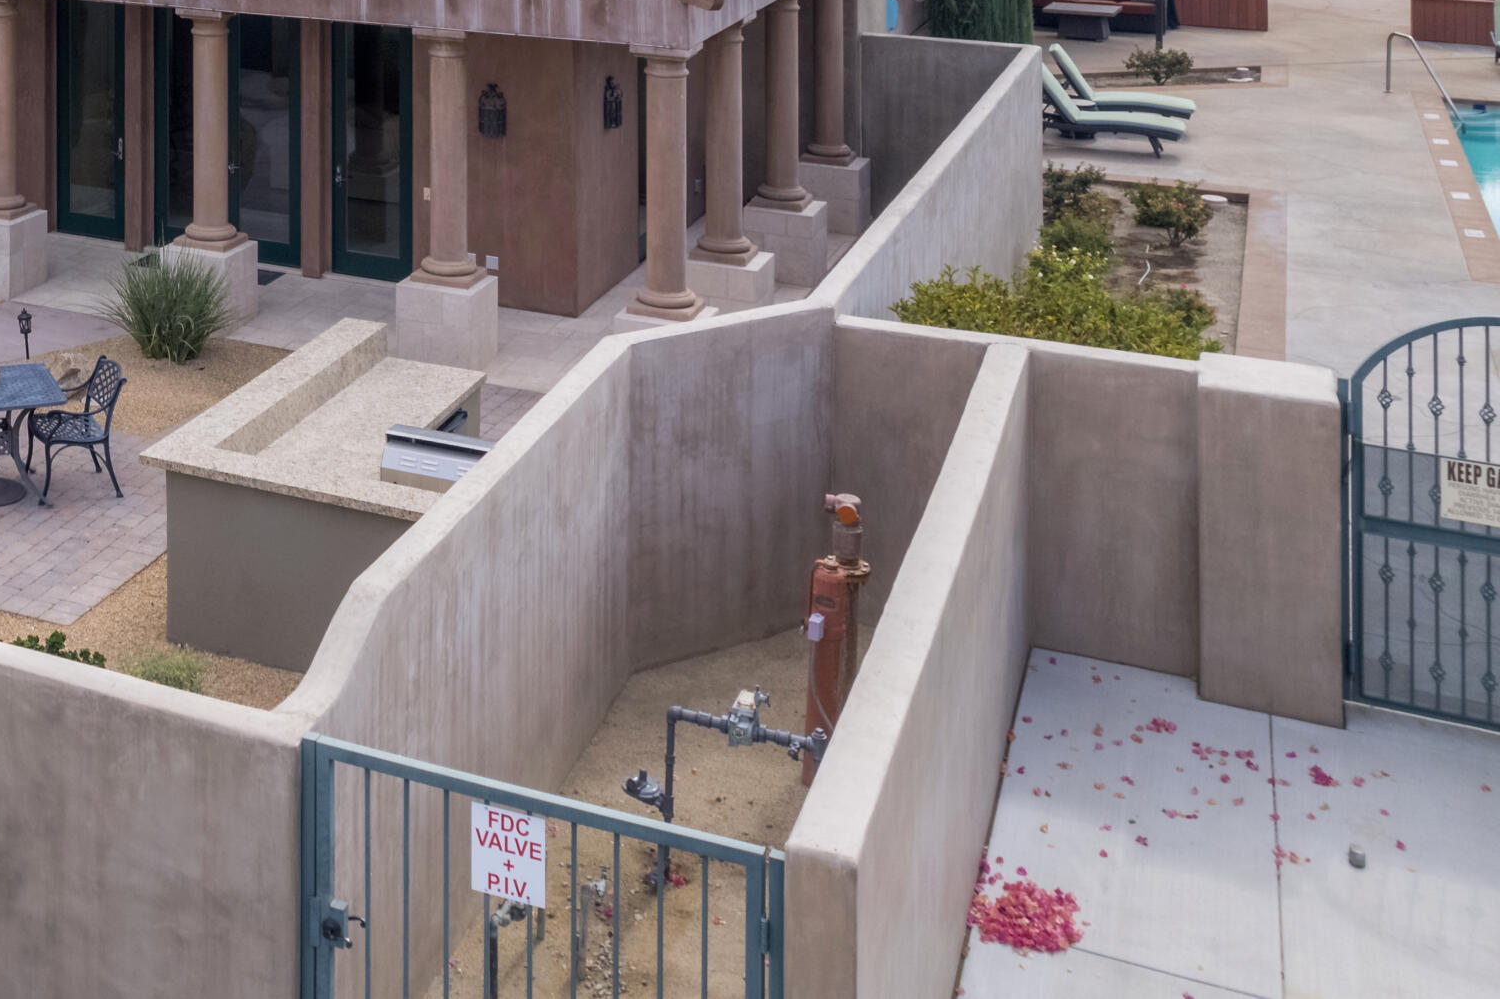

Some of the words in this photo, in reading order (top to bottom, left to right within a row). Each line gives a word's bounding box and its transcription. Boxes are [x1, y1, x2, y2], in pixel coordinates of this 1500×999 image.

[1447, 460, 1482, 485] KEEP
[488, 810, 529, 836] FDC
[475, 828, 542, 861] VALVE
[503, 860, 514, 872] +
[487, 873, 530, 900] P.I.V.
